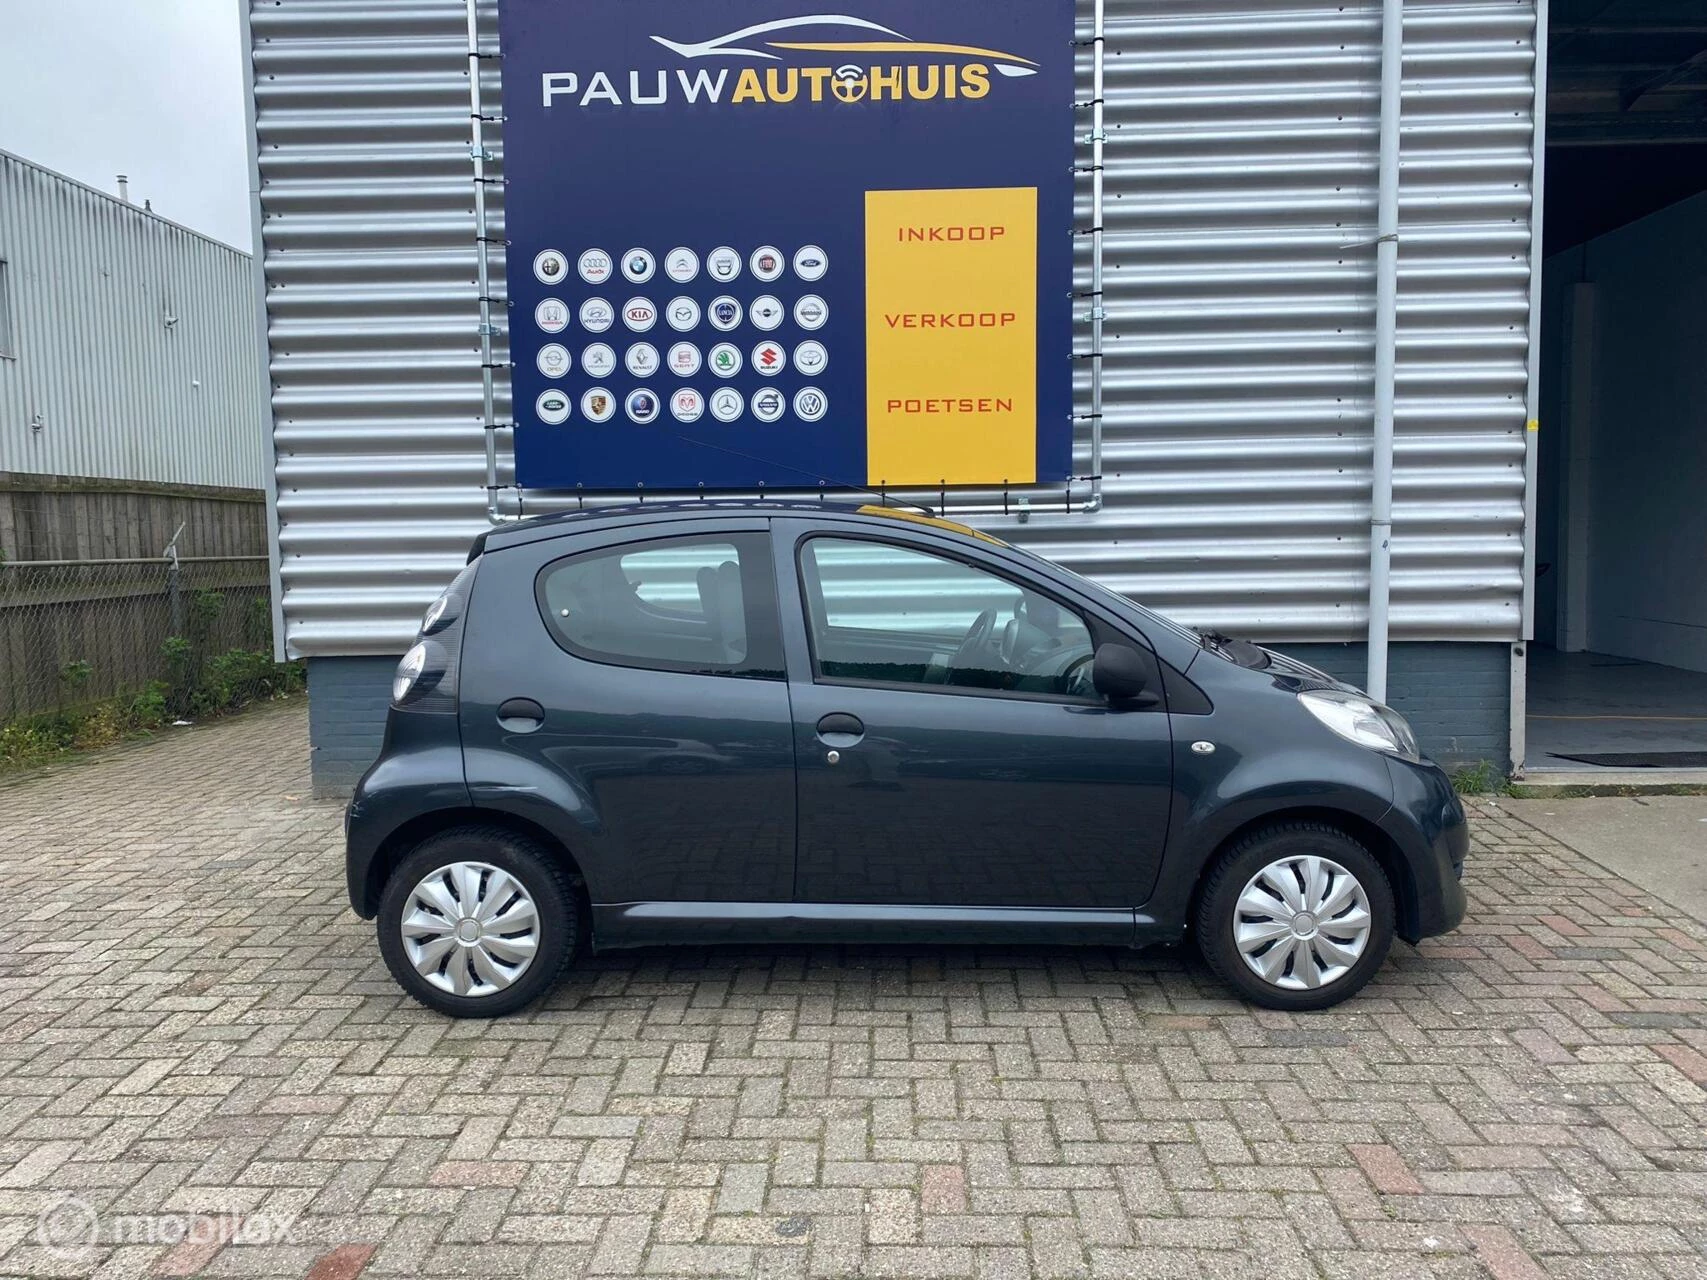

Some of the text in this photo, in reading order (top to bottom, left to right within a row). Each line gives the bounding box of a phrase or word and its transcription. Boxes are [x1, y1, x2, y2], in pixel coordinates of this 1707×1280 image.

[898, 226, 1005, 241] INKOOP
[631, 310, 649, 319] KIA
[885, 312, 1015, 328] VERKOOP
[887, 398, 1013, 413] POETSEN
